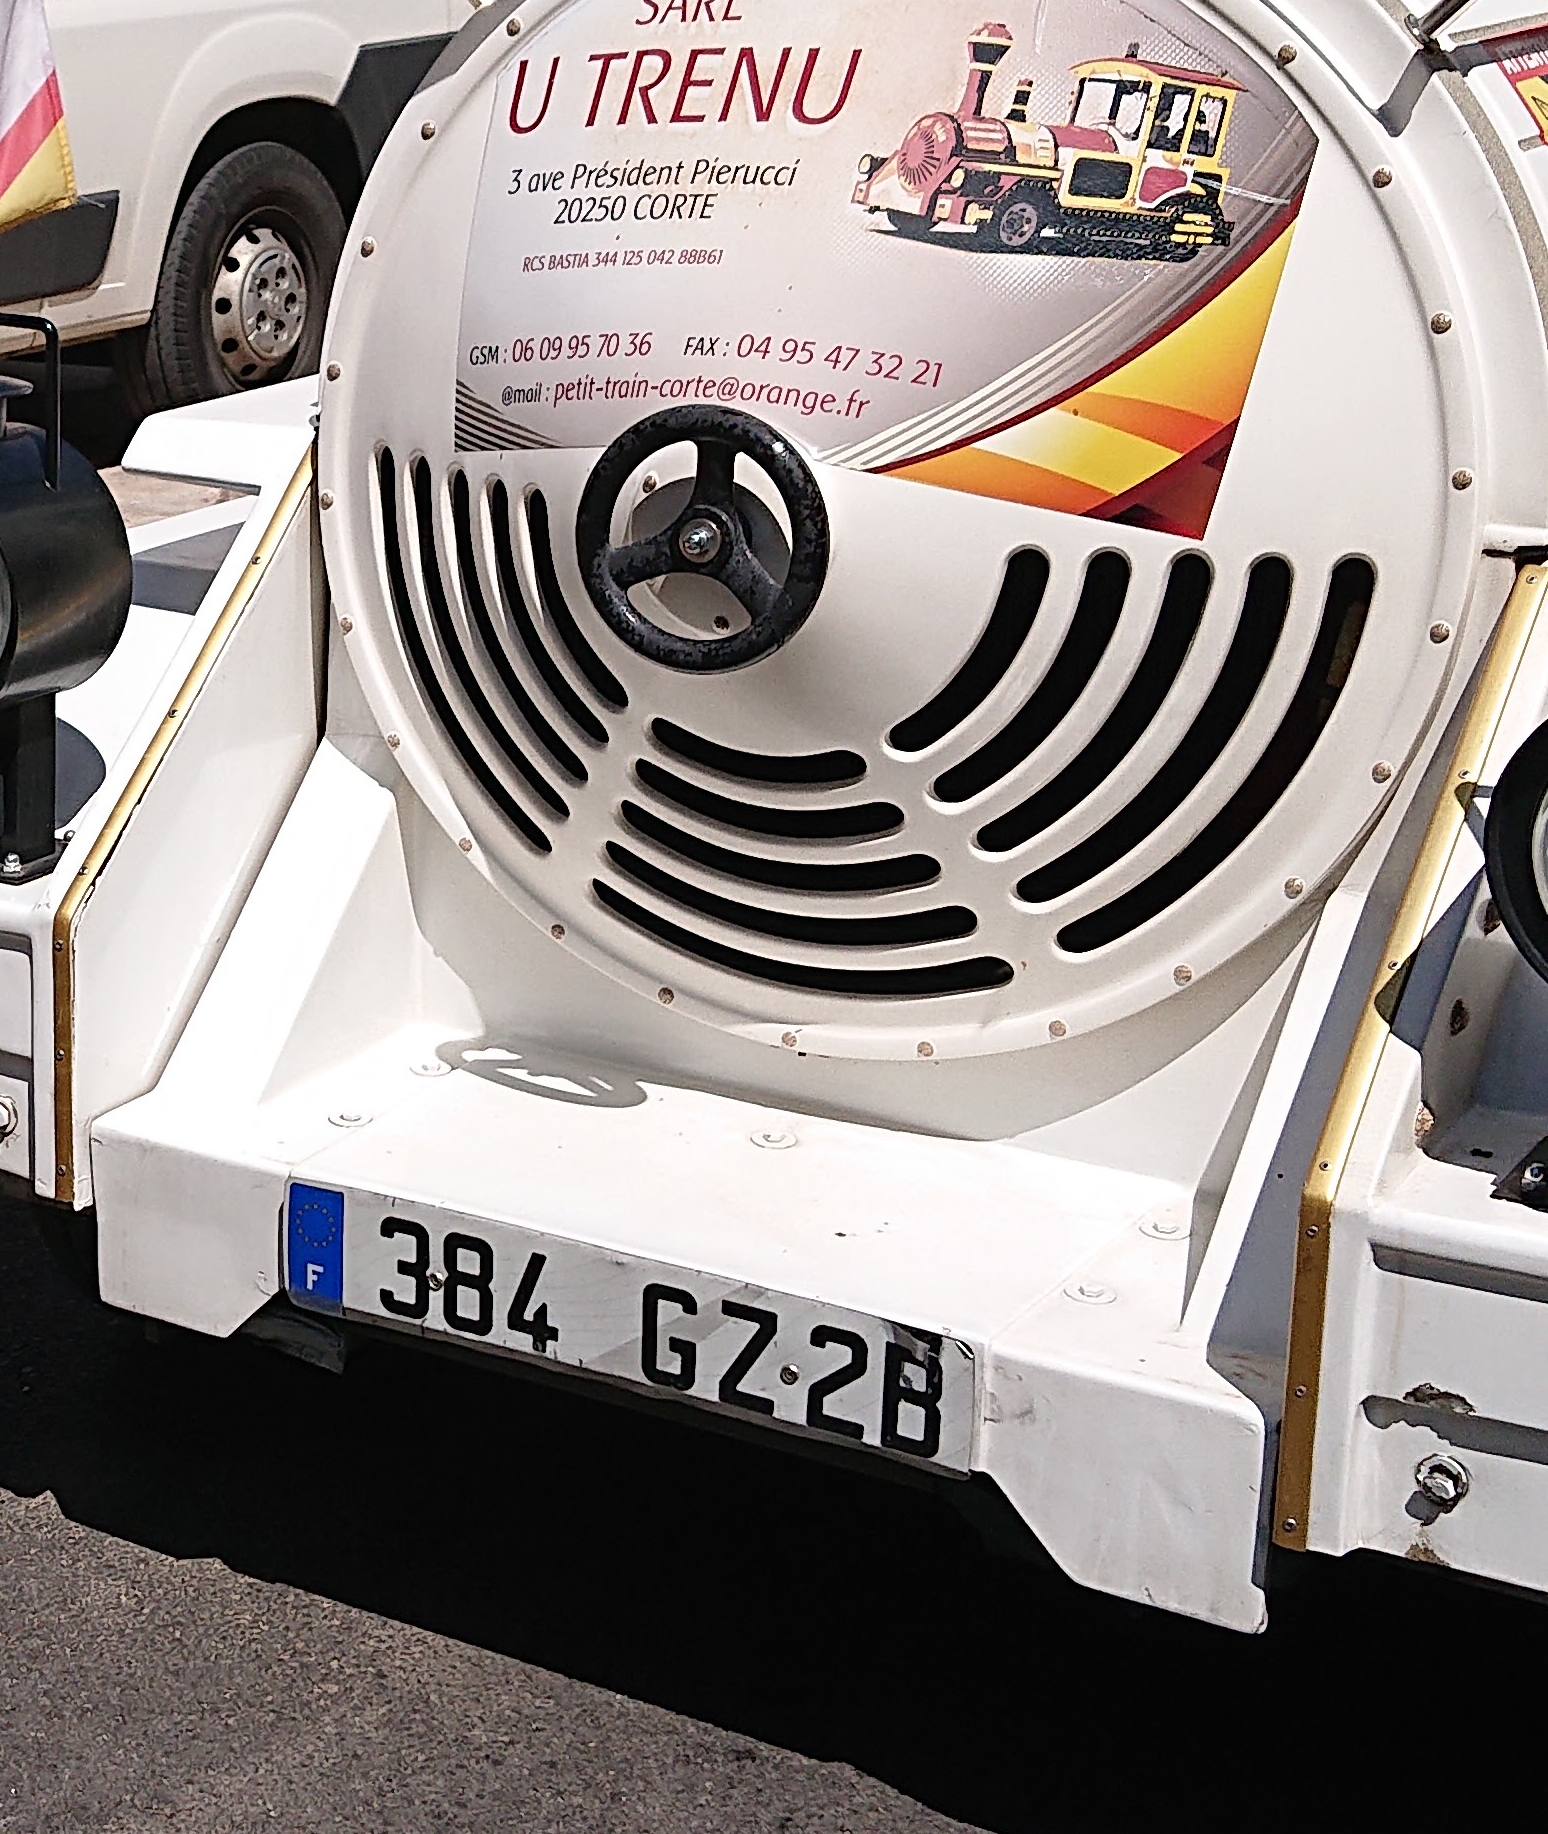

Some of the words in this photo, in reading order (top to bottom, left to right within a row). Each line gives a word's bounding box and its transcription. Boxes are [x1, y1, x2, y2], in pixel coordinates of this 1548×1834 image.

[509, 56, 560, 134] U
[584, 47, 862, 128] TRENU
[507, 168, 523, 194] 3
[527, 170, 565, 193] ave
[570, 159, 684, 190] Président
[689, 156, 800, 186] Pierucci
[553, 195, 627, 224] 20250
[633, 193, 718, 220] CORTE
[522, 255, 546, 272] RCS
[548, 252, 589, 270] BASTIA
[592, 250, 618, 267] 344
[622, 249, 644, 266] 125
[647, 249, 675, 265] 042
[512, 337, 535, 363] 06
[539, 336, 563, 361] 09
[567, 334, 592, 359] 95
[596, 333, 620, 358] 70
[624, 332, 653, 357] 36
[736, 333, 772, 360] 04
[779, 338, 816, 365] 95
[823, 345, 861, 372] 47
[864, 350, 903, 381] 32
[910, 359, 943, 388] 21
[553, 372, 870, 419] petit-train-corte@orange.fr
[305, 1262, 325, 1292] F
[378, 1215, 560, 1354] 384
